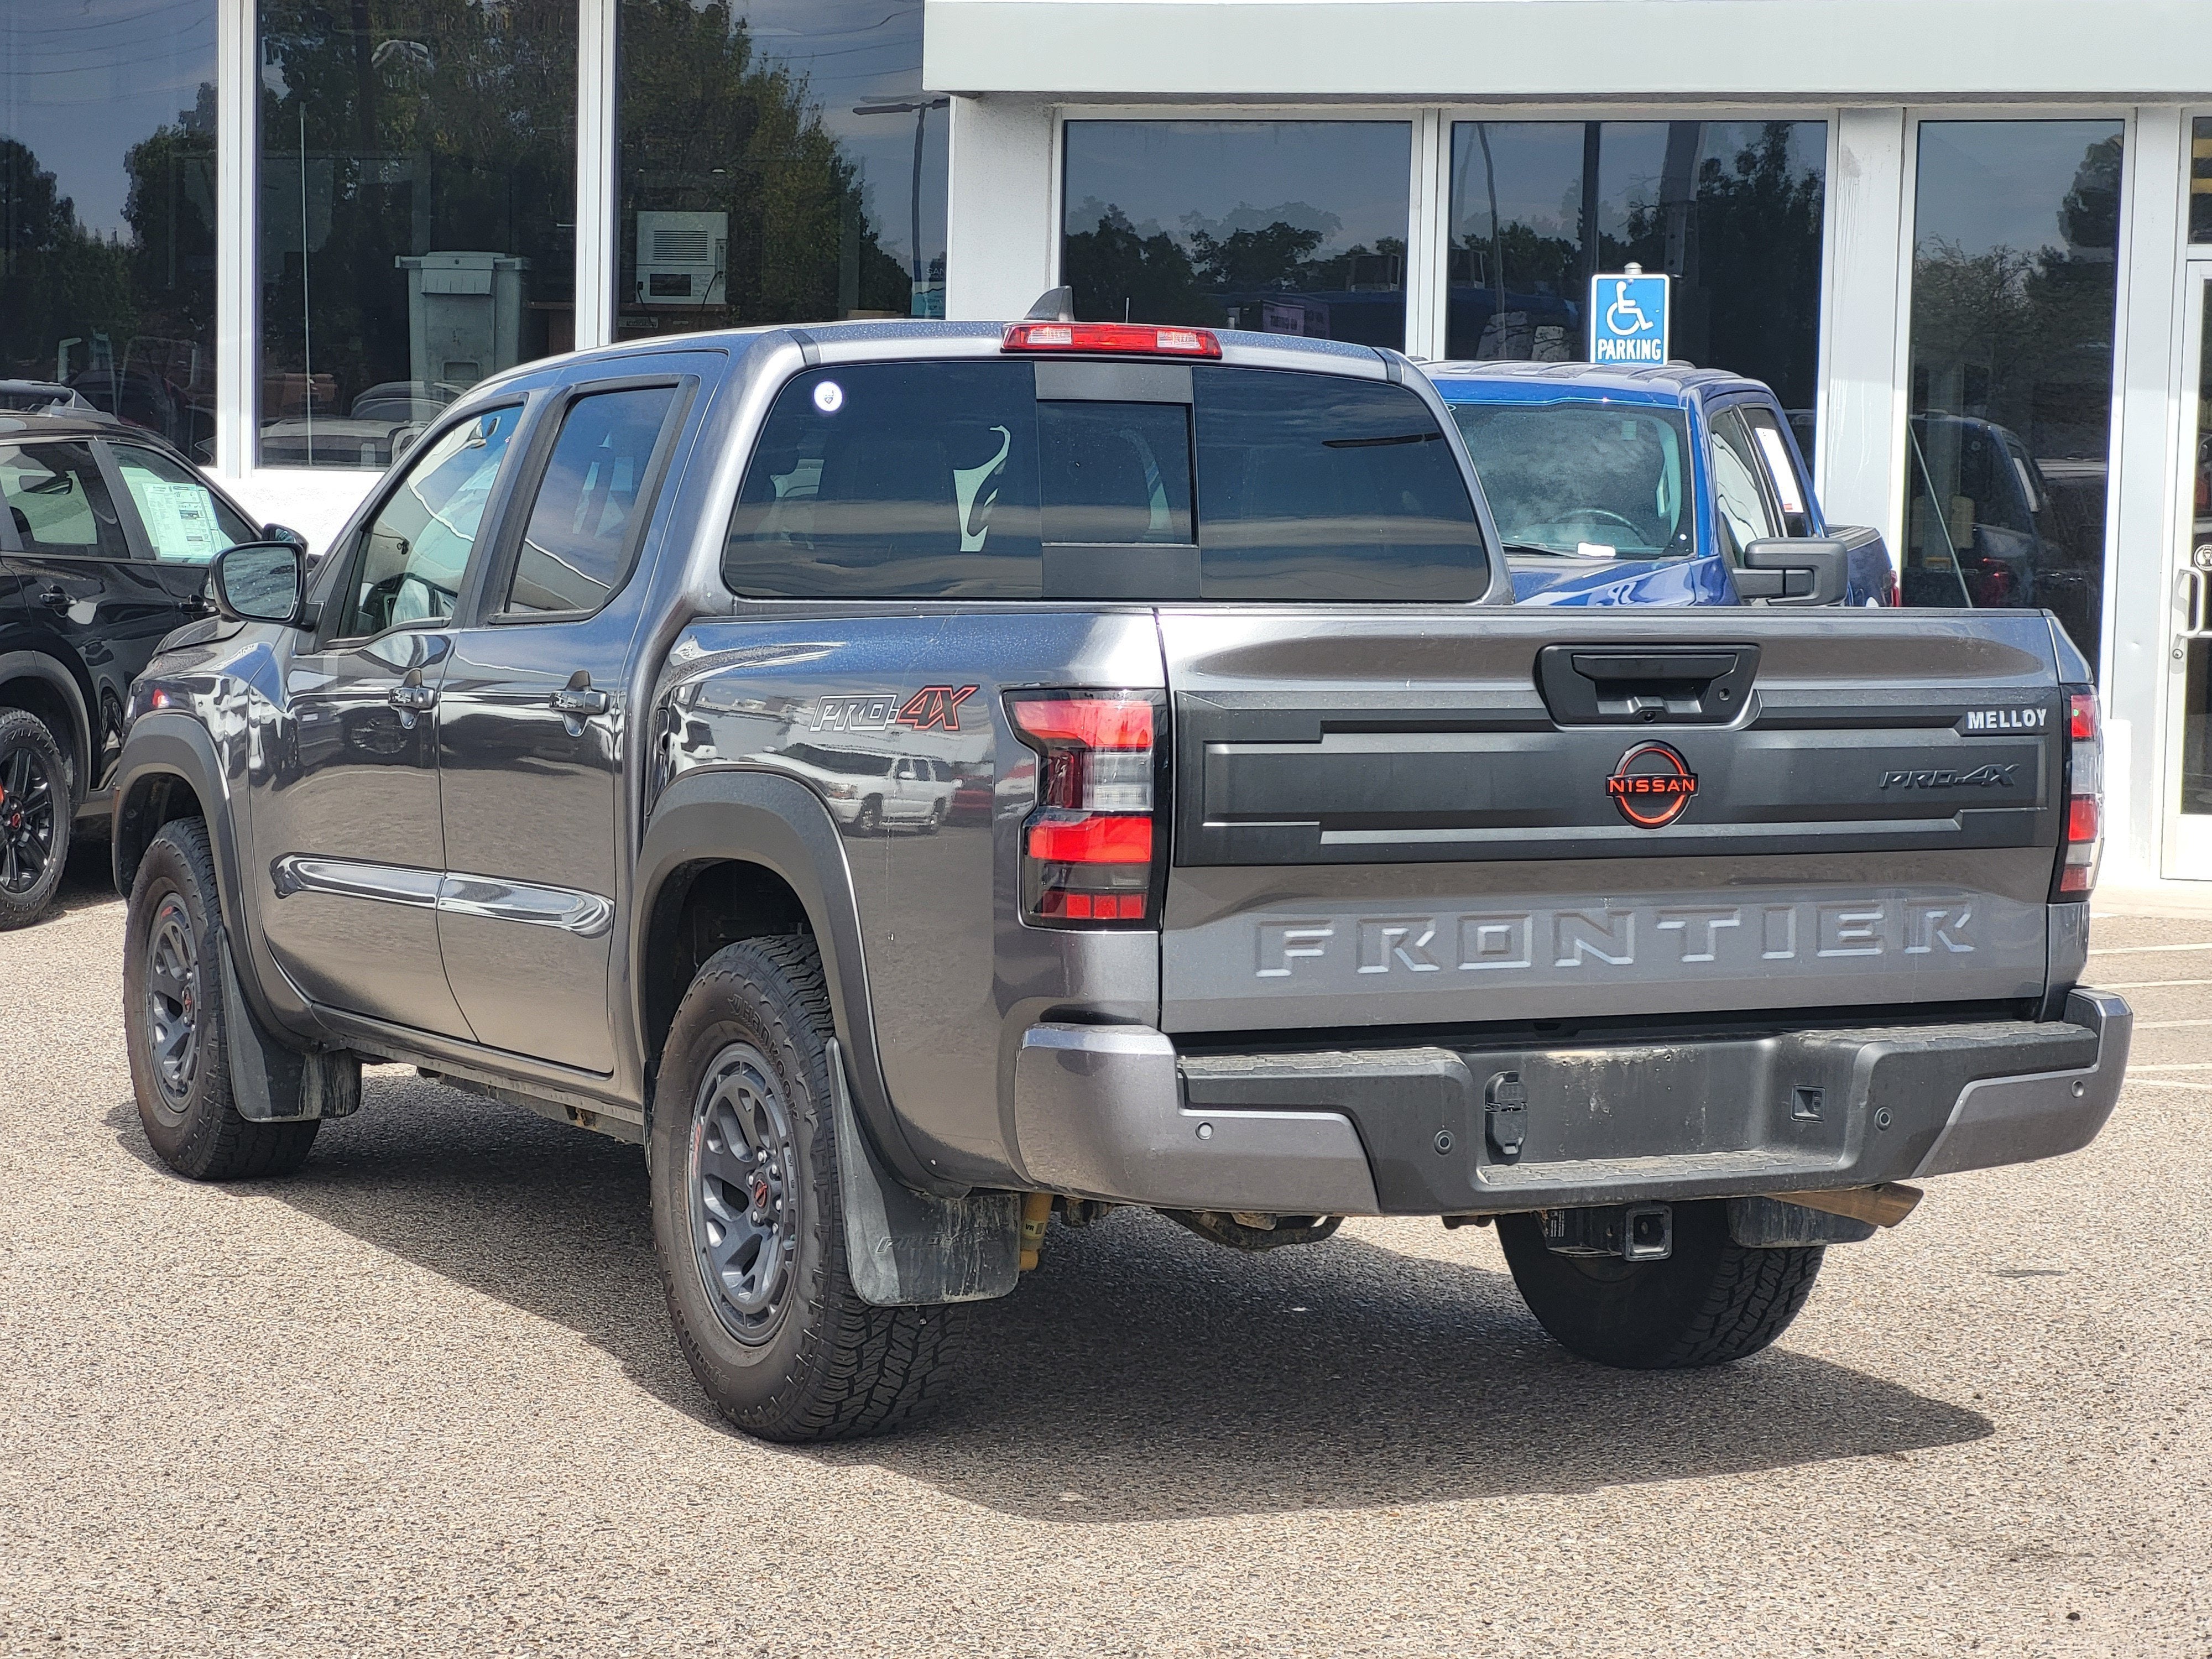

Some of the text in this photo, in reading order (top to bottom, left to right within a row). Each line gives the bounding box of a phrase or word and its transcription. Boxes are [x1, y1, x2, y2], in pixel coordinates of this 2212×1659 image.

[1598, 338, 1661, 360] PARKING
[809, 684, 980, 732] PRO-4X
[1967, 708, 2048, 729] MELLOY
[1609, 779, 1696, 794] NISSAN
[1879, 763, 2020, 789] PRO-4X
[1254, 898, 1975, 978] FRONTIER
